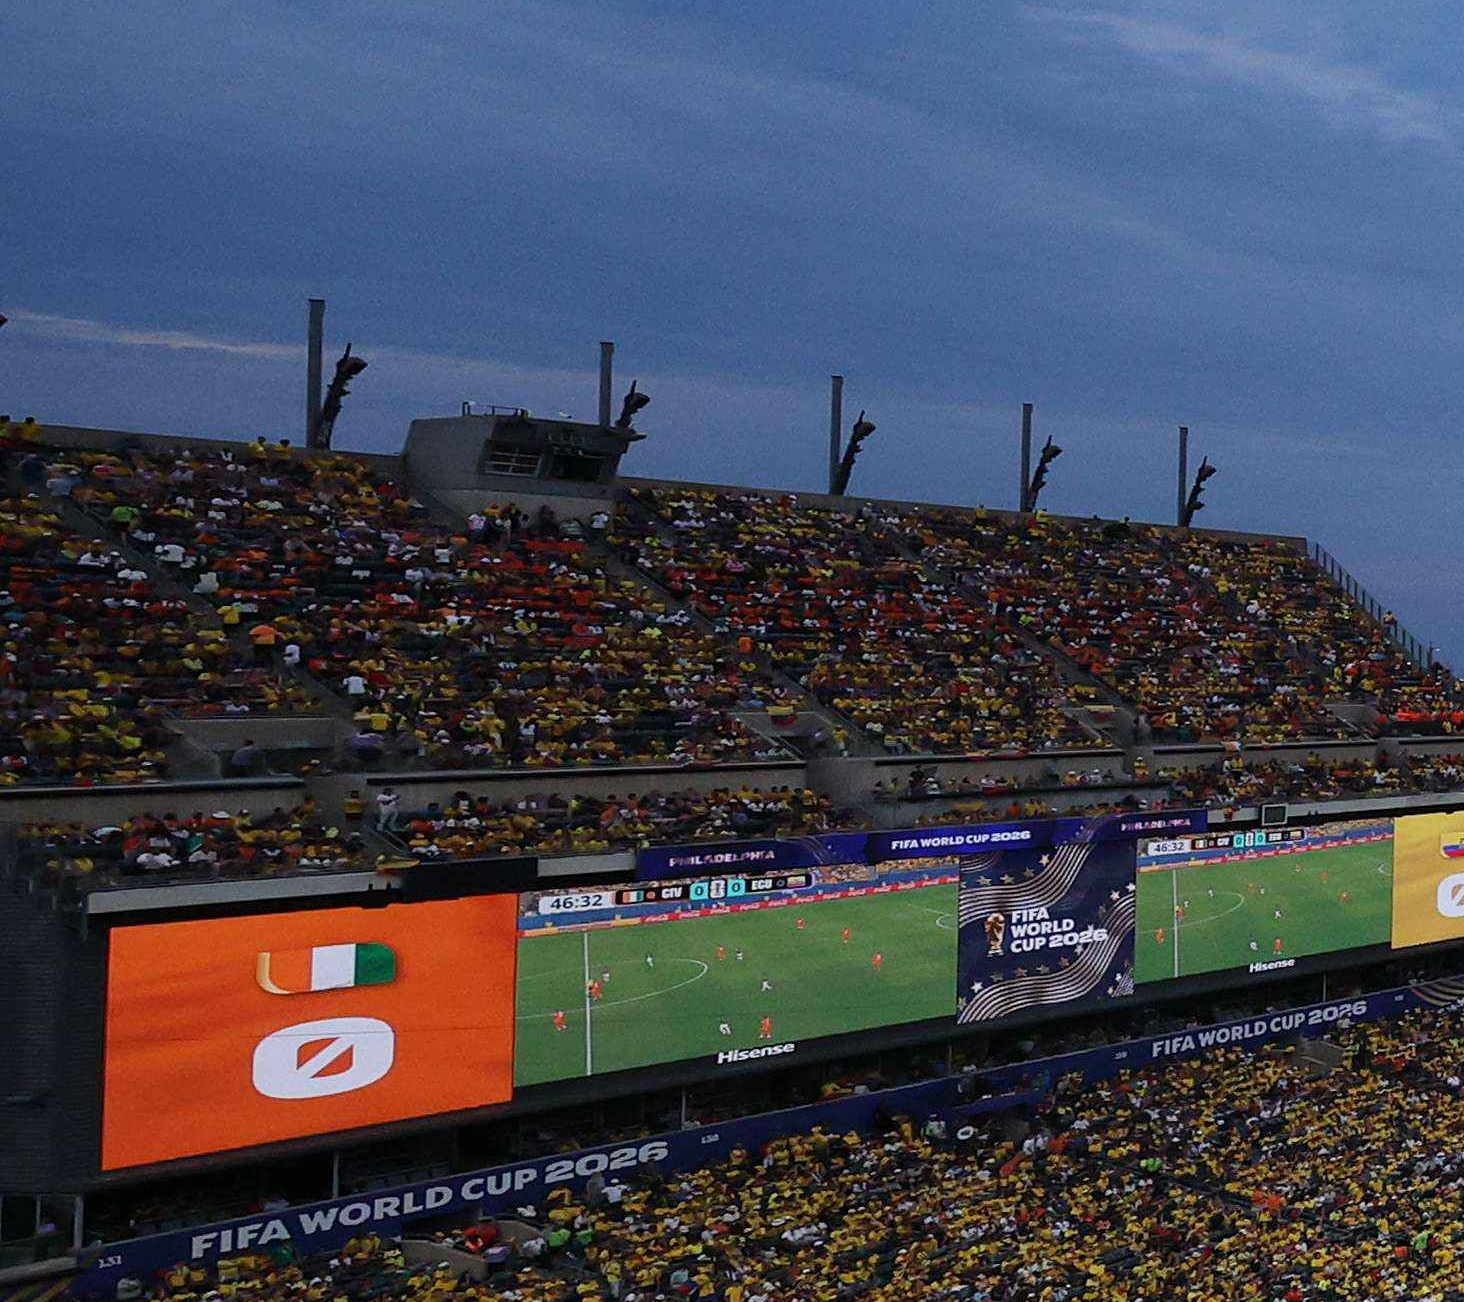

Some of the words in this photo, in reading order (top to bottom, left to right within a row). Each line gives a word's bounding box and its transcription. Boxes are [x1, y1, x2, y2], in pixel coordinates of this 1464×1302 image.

[891, 839, 919, 851] FIFA
[921, 835, 965, 849] WORLD
[966, 833, 991, 845] CUP
[991, 830, 1031, 842] 2026
[669, 849, 776, 867] PHILADELPHIA
[550, 894, 603, 910] 46:32
[1011, 907, 1050, 924] FIFA
[1010, 918, 1074, 938] WORLD
[1010, 938, 1045, 954] CUP
[1048, 928, 1108, 949] 2026
[1249, 958, 1295, 974] Hisense
[1152, 1035, 1195, 1058] FIFA
[1198, 1020, 1266, 1048] WORLD
[1270, 1011, 1306, 1033] CUP
[1308, 1000, 1367, 1026] 2026
[717, 1041, 796, 1064] Hisense
[191, 1217, 289, 1260] FIFA
[299, 1184, 453, 1236] WORLD
[460, 1166, 537, 1202] CUP
[544, 1140, 669, 1184] 2026
